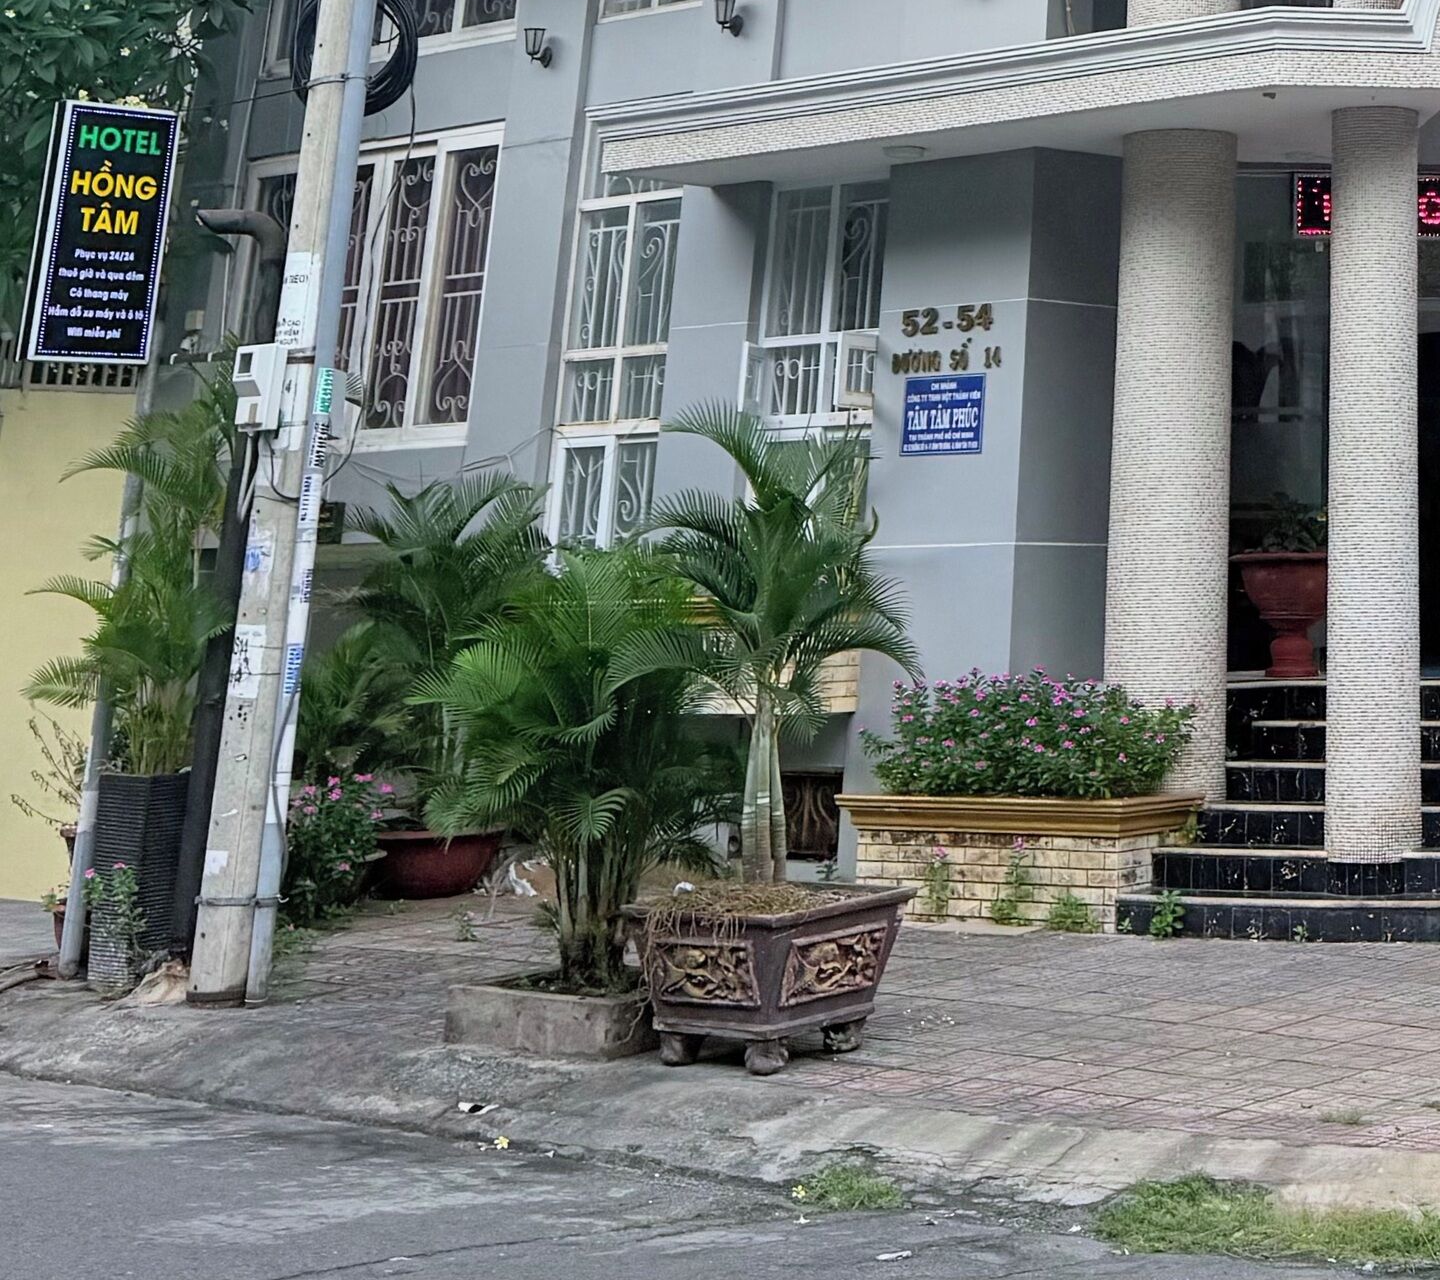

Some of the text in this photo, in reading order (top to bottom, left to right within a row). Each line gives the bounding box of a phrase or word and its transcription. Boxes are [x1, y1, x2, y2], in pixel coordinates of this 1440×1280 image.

[78, 124, 161, 156] HOTEL
[70, 159, 157, 201] HỒNG
[80, 202, 139, 235] TÂM
[109, 251, 135, 261] 24/24
[907, 402, 978, 430] TÂM TÂM PHÚC
